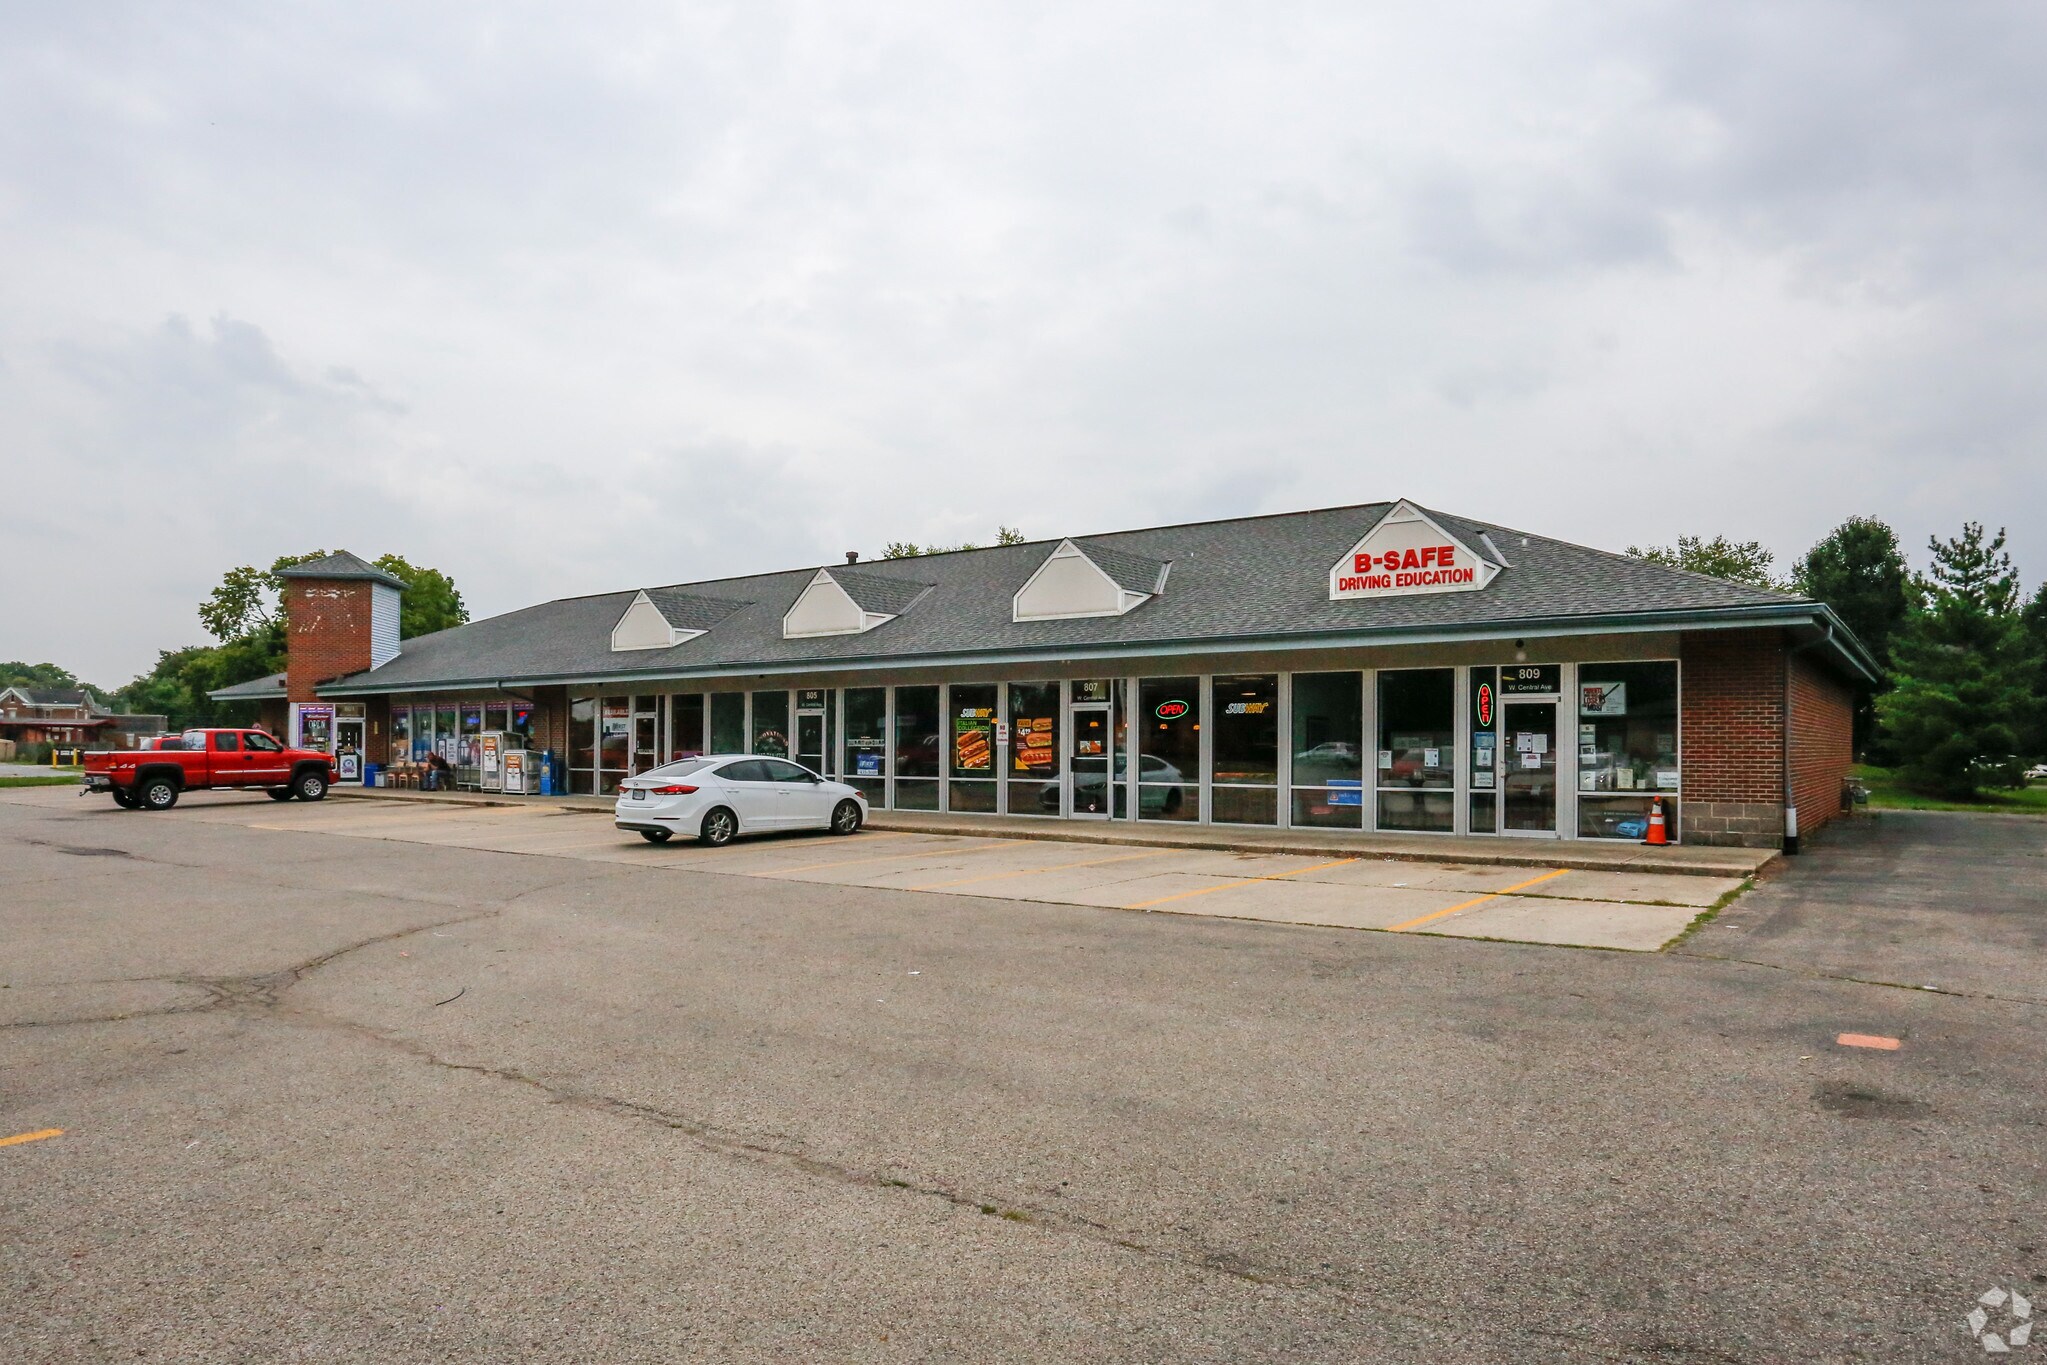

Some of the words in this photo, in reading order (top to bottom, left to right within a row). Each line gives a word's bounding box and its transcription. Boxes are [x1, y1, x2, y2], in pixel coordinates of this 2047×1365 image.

[1354, 545, 1455, 573] B-SAFE
[1339, 574, 1391, 591] DRIVING
[1395, 568, 1473, 587] EDUCATION
[1518, 668, 1541, 679] 809
[1083, 682, 1098, 691] 807
[806, 691, 818, 699] 805
[960, 707, 992, 718] SUBWAY
[1160, 704, 1185, 715] OPEN
[1225, 702, 1269, 714] SUBWAY
[308, 720, 326, 729] OPEN
